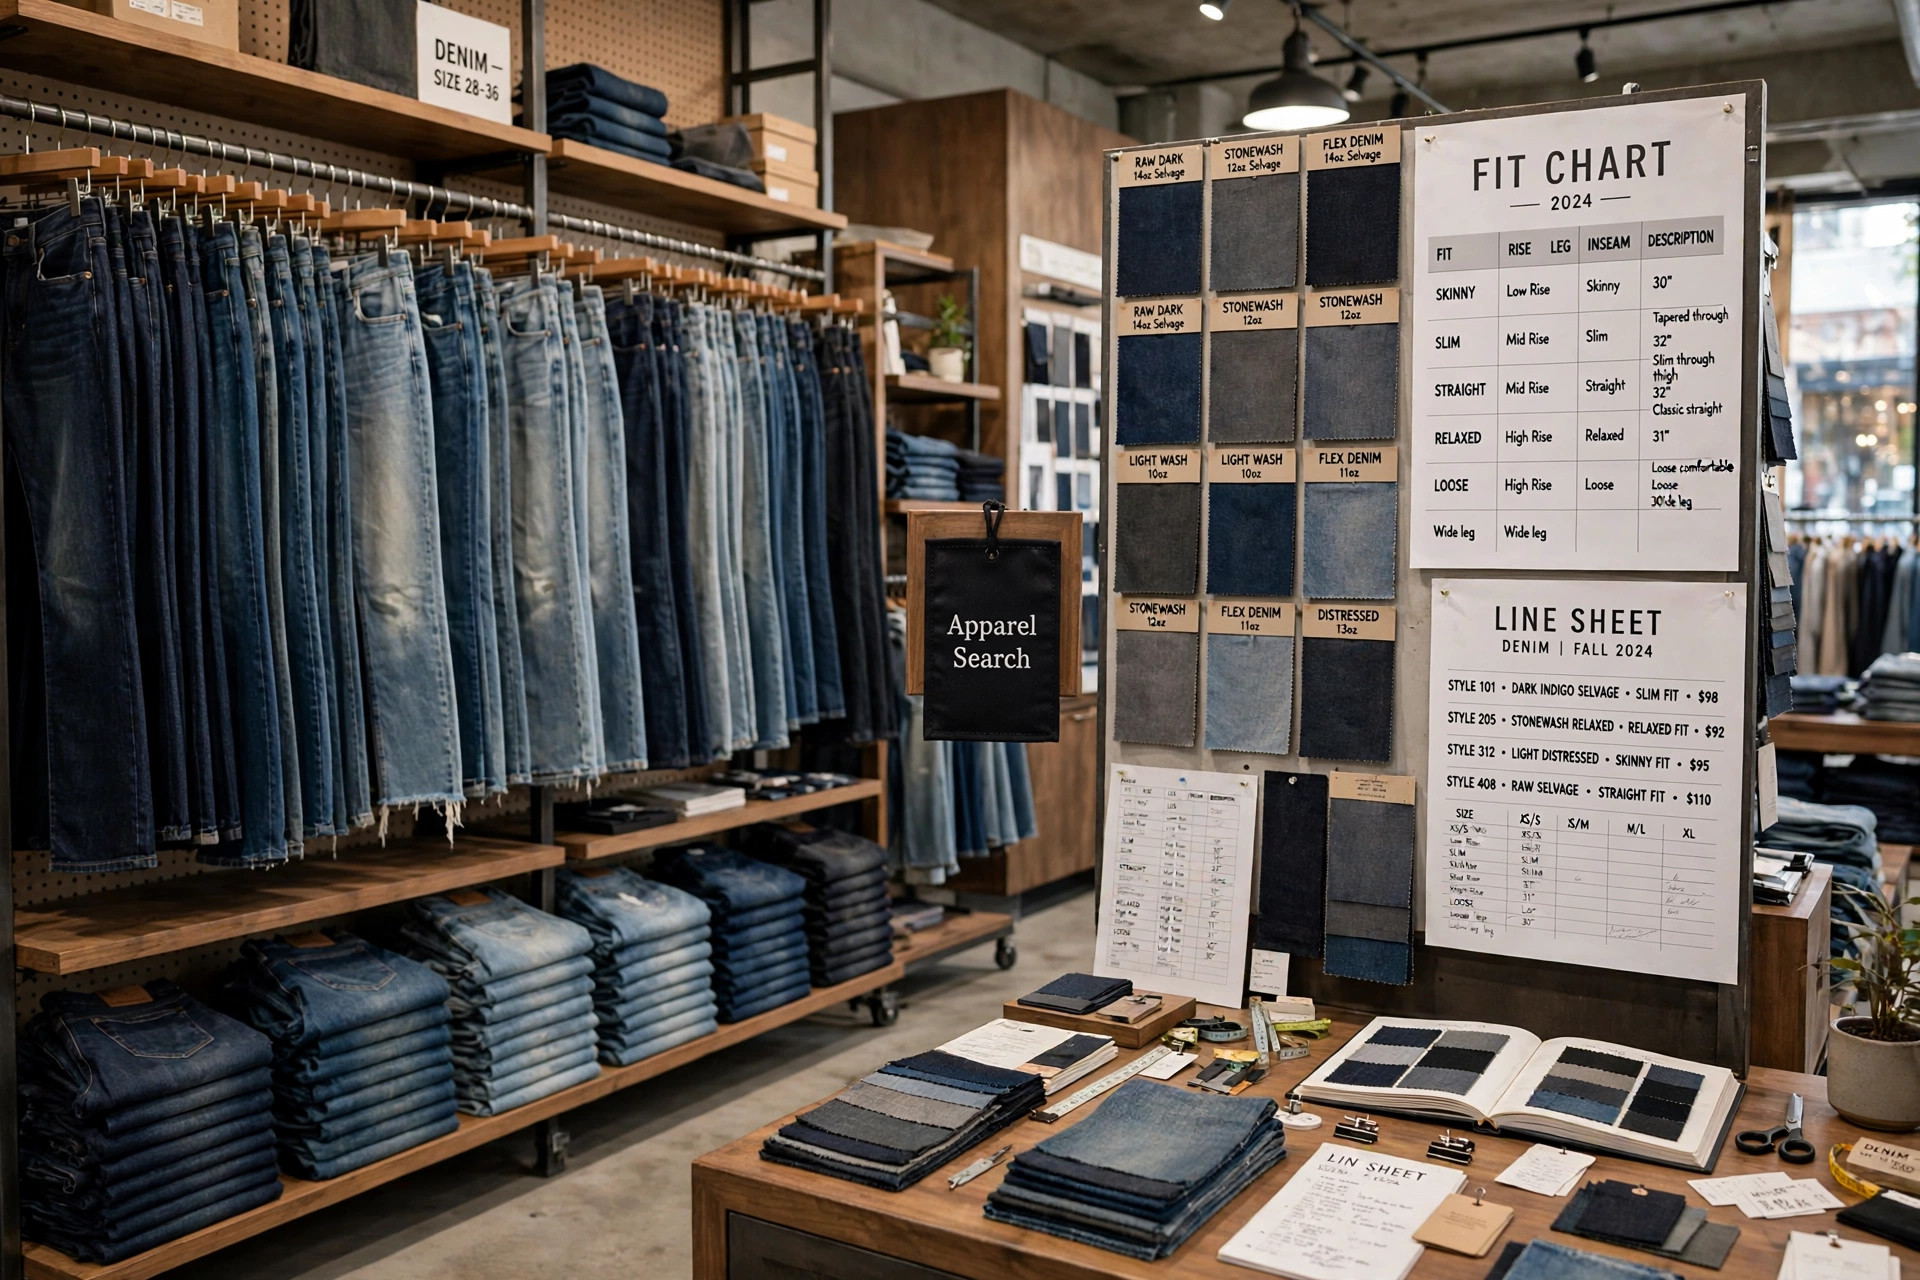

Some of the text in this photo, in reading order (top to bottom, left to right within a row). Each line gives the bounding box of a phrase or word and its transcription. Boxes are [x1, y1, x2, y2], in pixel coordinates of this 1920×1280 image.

[435, 38, 488, 73] DENIM
[434, 69, 499, 101] SIZE 28-36
[1323, 133, 1384, 150] FLEX DENIM
[1225, 144, 1283, 159] STONEWASH
[1325, 149, 1381, 163] 14oz Selvage
[1135, 153, 1184, 167] RAW DARK
[1227, 159, 1281, 173] 12oz Selvage
[1473, 140, 1671, 191] FIT CHART
[1133, 167, 1185, 181] 14oz Selvage
[1551, 193, 1592, 211] 2024
[1436, 230, 1714, 261] FIT RISE LEG INSEAM DESCRIPTION
[1436, 276, 1672, 301] SKINNY Low Rise Skinny 30"
[1223, 300, 1283, 313] STONEWASH
[1319, 294, 1383, 308] STONEWASH
[1134, 304, 1183, 316] RAW DARK
[1341, 310, 1361, 320] 12oz
[1653, 307, 1729, 325] Tapered through
[1133, 318, 1184, 331] 14oz Selvage
[1243, 315, 1262, 325] 12oz
[1435, 330, 1672, 349] SLIM Mid Rise Slim 32"
[1653, 352, 1715, 368] Slim through
[1653, 369, 1678, 384] thigh
[1434, 379, 1671, 398] STRAIGHT Mid Rise Straight 32"
[1653, 403, 1722, 417] Classic straight
[1434, 429, 1669, 447] RELAXED High Rise Relaxed 31"
[1129, 454, 1188, 466] LIGHT WASH
[1221, 453, 1283, 465] LIGHT WASH
[1319, 452, 1382, 464] FLEX DENIM
[1148, 469, 1168, 479] 10oz
[1241, 468, 1261, 479] 10oz
[1340, 468, 1359, 478] 11oz
[1652, 460, 1734, 473] Loose comfortable
[1434, 479, 1678, 495] LOOSE High Rise Loose Loose
[1678, 495, 1692, 510] leg
[1434, 525, 1547, 541] Wide leg Wide leg
[1129, 603, 1186, 615] STONEWASH
[1221, 606, 1281, 619] FLEX DENIM
[1318, 609, 1379, 622] DISTRESSED
[947, 614, 1037, 641] Apparel
[1241, 621, 1260, 631] 11oz
[1495, 605, 1661, 635] LINE SHEET
[1337, 624, 1357, 634] 13oz
[1503, 640, 1653, 658] DENIM FALL 2024
[954, 647, 1030, 669] Search
[1448, 679, 1718, 703] STYLE 101 DARK INDIGO SELVAGE SLIM FIT $98
[1448, 711, 1725, 738] STYLE 205 STONEWASH RELAXED RELAXED FIT $92
[1447, 744, 1709, 771] STYLE 312 LIGHT DISTRESSED SKINNY FIT $95
[1447, 775, 1711, 806] STYLE 408 RAW SELVAGE STRAIGHT FIT $110
[1456, 809, 1695, 839] SIZE XS/S S/M M/L XL
[1327, 1153, 1359, 1167] LIN
[1366, 1162, 1427, 1182] SHEET
